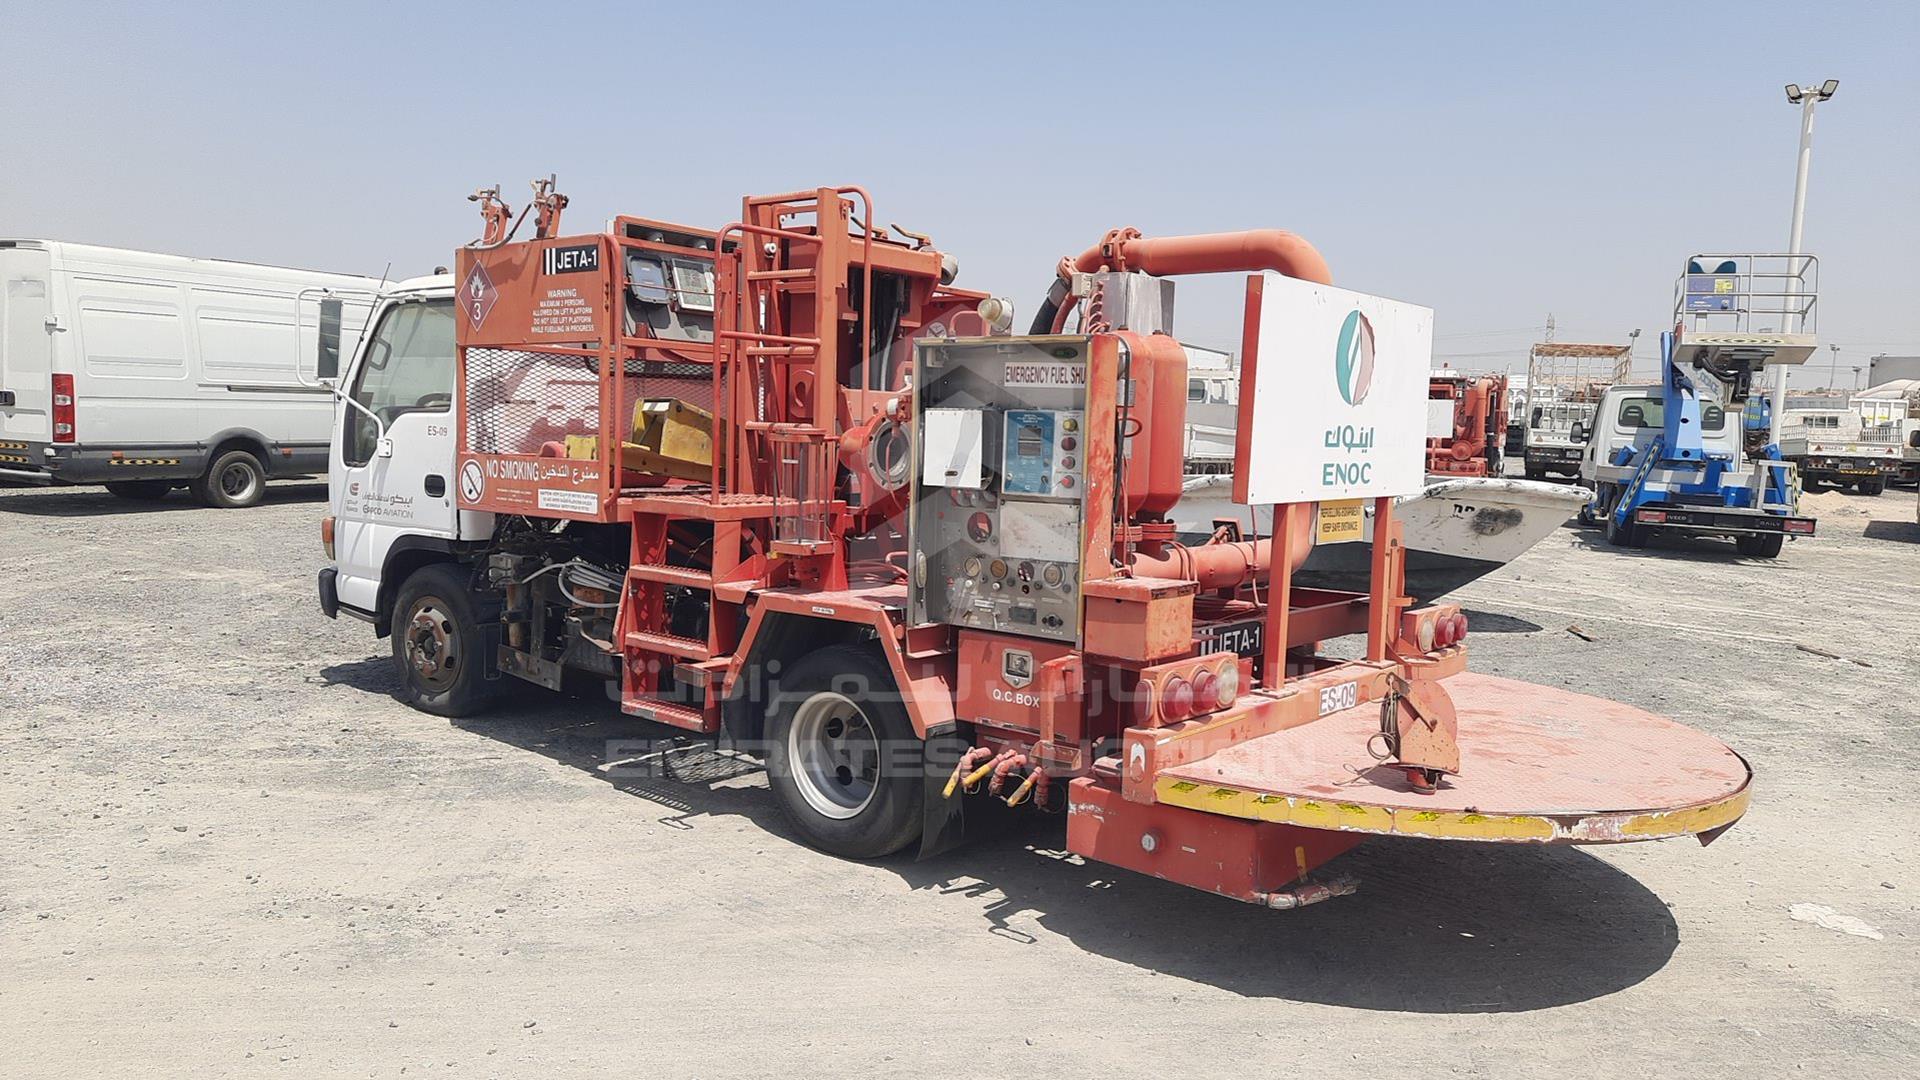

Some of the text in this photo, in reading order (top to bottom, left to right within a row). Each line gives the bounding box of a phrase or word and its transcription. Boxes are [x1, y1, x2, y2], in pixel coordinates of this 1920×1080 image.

[547, 288, 577, 299] WARNING
[540, 300, 560, 308] MAXIMUM
[564, 299, 585, 307] PERSONS
[569, 306, 593, 315] PLATFORM
[473, 302, 482, 321] 3
[533, 317, 540, 325] DO
[541, 317, 550, 325] NOT
[559, 316, 568, 324] LIFT
[568, 315, 592, 323] PLATFORM
[544, 325, 564, 333] FUELLING
[570, 324, 594, 332] PROGRESS
[1005, 366, 1050, 384] EMERGENCY
[1051, 366, 1069, 384] FUEL
[427, 425, 448, 436] ES-09
[486, 460, 539, 481] NO SMOKING
[540, 464, 599, 485] ممنوع التدخين
[1322, 462, 1372, 486] ENOC
[1320, 683, 1356, 713] ES-09
